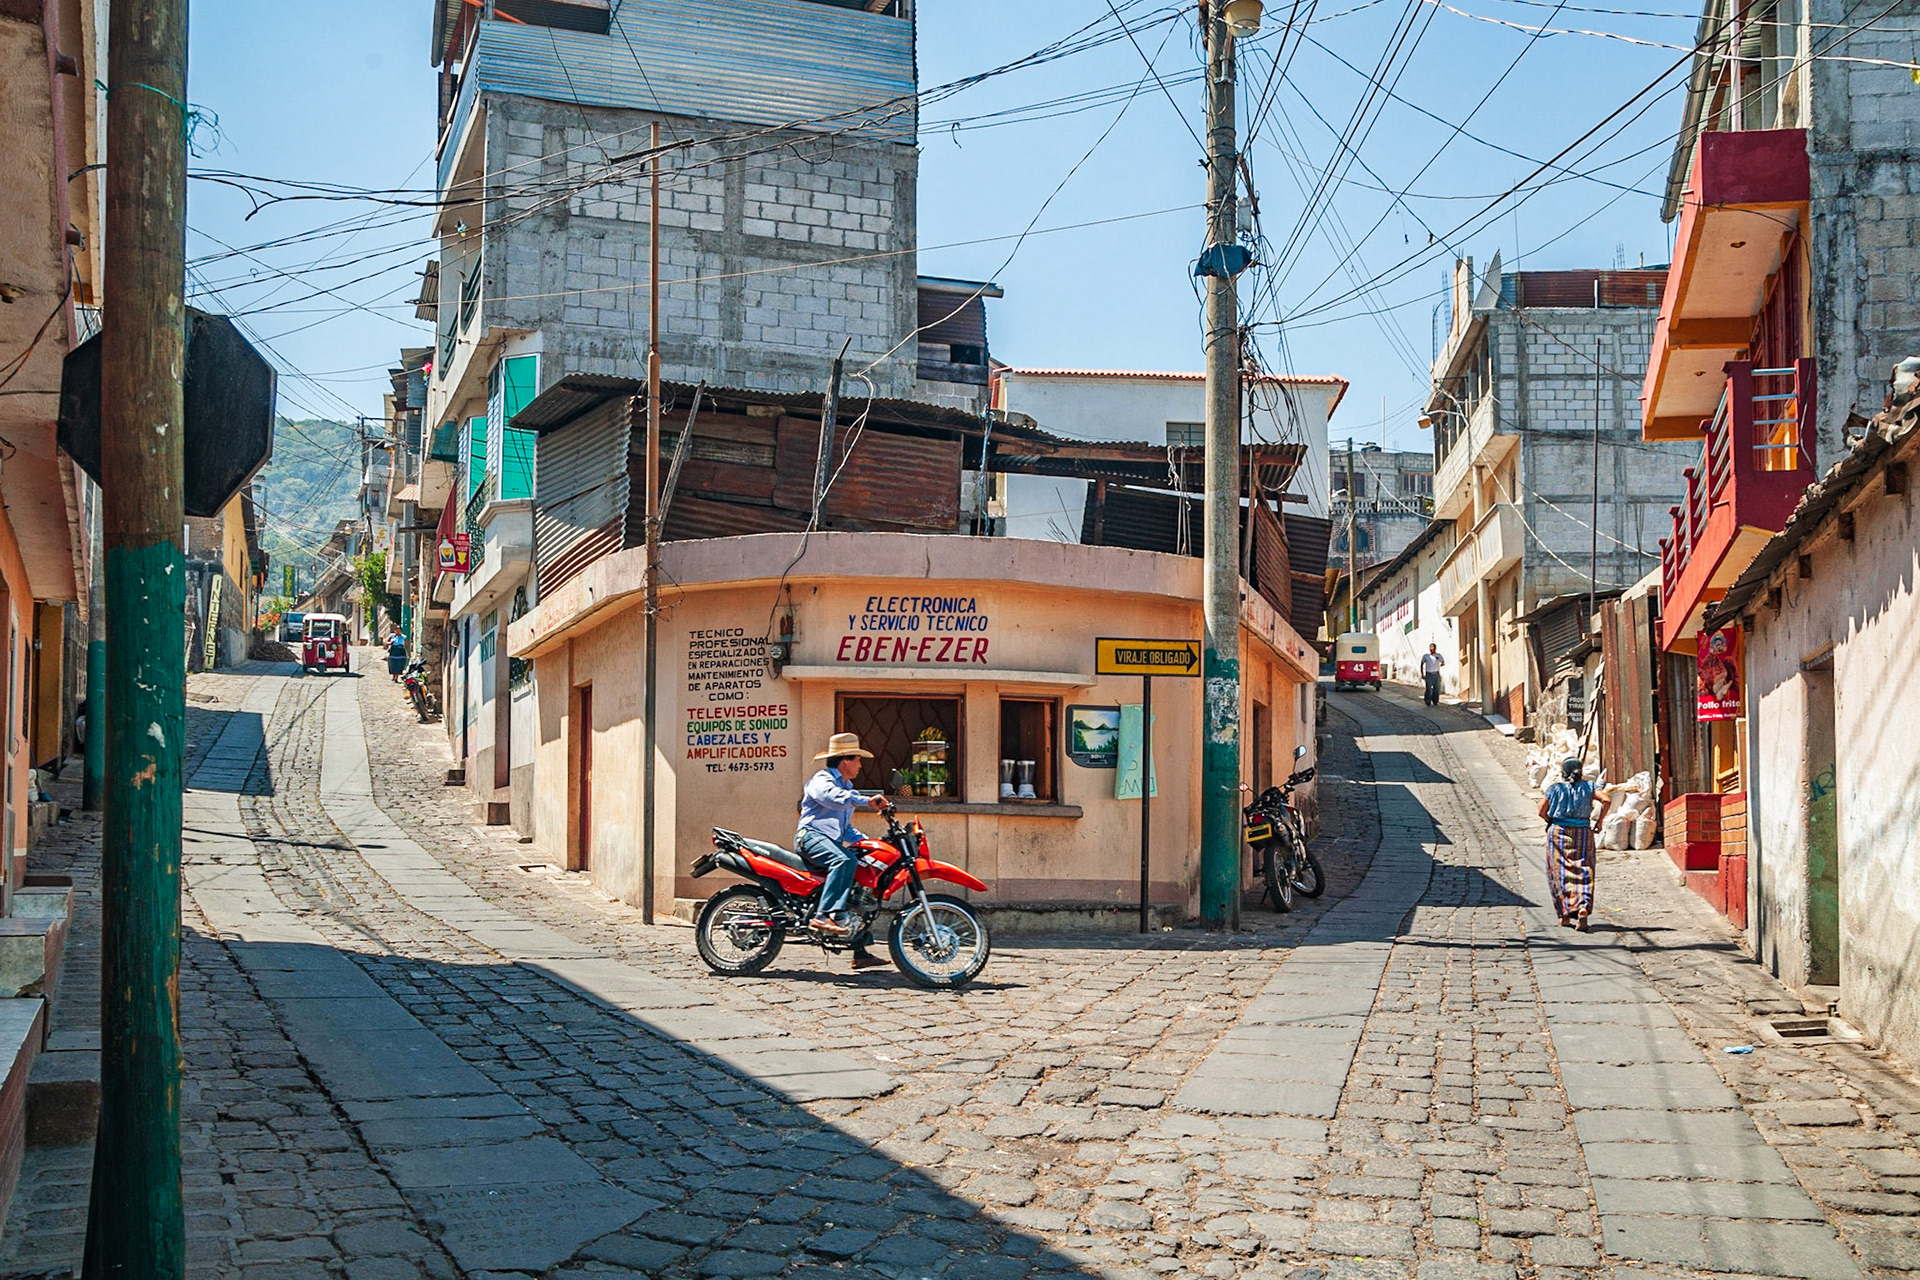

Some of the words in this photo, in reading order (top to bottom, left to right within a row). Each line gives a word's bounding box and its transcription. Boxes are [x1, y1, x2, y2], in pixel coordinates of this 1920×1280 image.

[866, 597, 976, 613] ELECTRONICA
[205, 579, 220, 665] INTERNET
[849, 615, 856, 630] Y
[860, 615, 920, 631] SERVICIO
[927, 615, 988, 631] TECNICO
[689, 628, 744, 639] TECNICO
[690, 637, 772, 649] PROFESIONAL
[689, 648, 765, 659] ESPECIALIZADO
[836, 636, 989, 664] EBEN-EZER
[1117, 650, 1148, 664] VIRAJE
[1149, 651, 1191, 664] OBLIGADO
[688, 661, 697, 670] EN
[699, 658, 769, 669] REPARACIONES
[1353, 663, 1365, 672] 43
[688, 668, 764, 680] MANTENIMIENTO
[688, 683, 701, 691] DE
[705, 680, 761, 690] APARATOS
[687, 704, 788, 719] TELEVISORES
[1697, 701, 1720, 710] Pollo
[1722, 700, 1741, 708] frito
[687, 720, 732, 734] EQUIPOS
[735, 719, 746, 731] DE
[749, 718, 788, 731] SONIDO
[687, 733, 759, 746] CABEZALES
[764, 732, 771, 744] Y
[687, 745, 787, 759] AMPLIFICADORES
[706, 763, 726, 773] TEL:
[728, 762, 775, 772] 4673-5773
